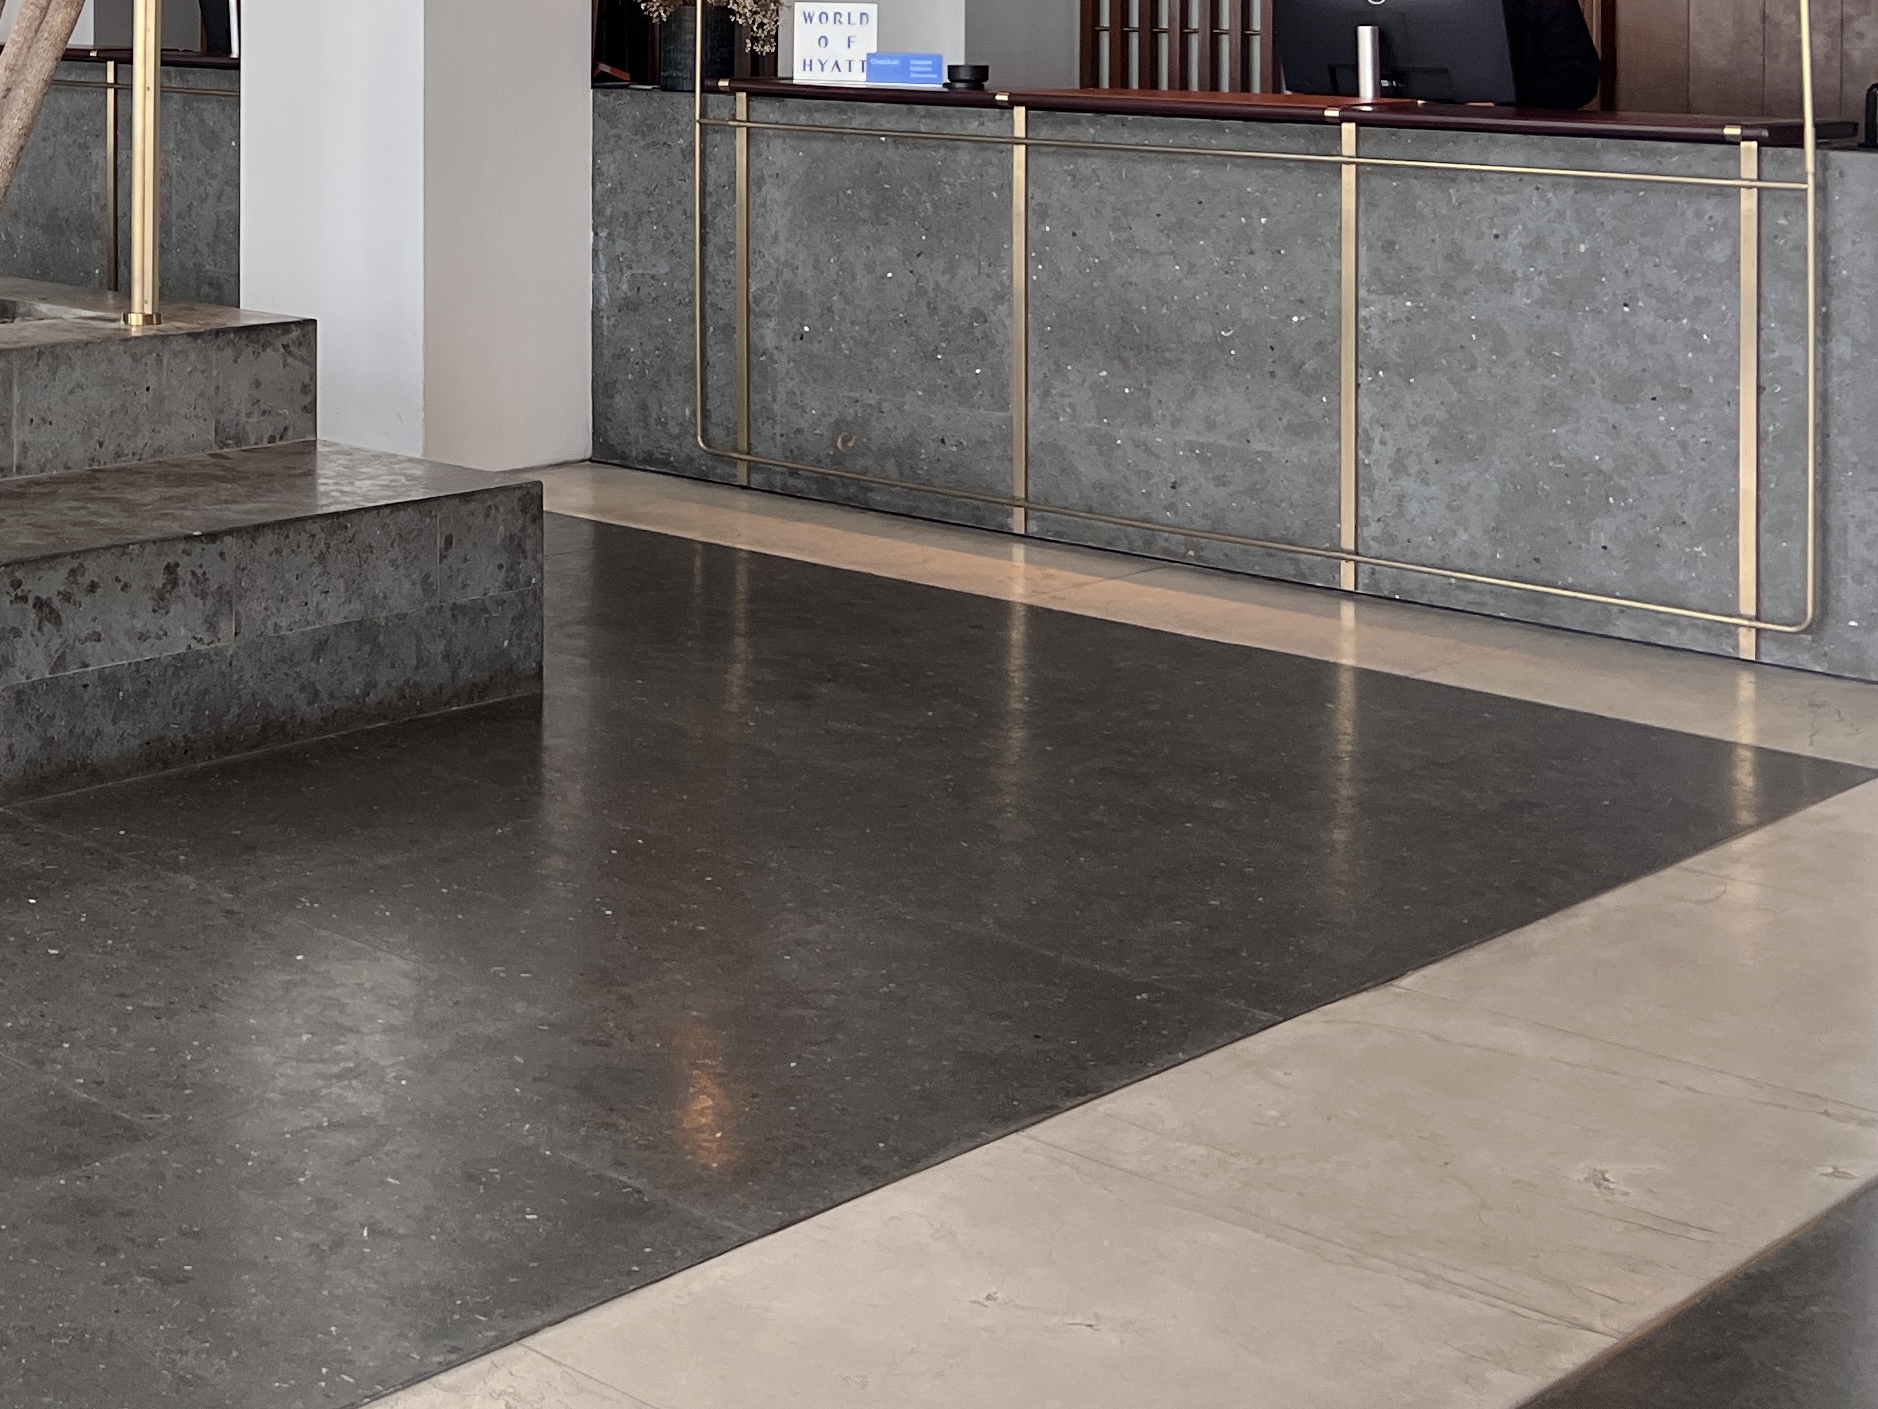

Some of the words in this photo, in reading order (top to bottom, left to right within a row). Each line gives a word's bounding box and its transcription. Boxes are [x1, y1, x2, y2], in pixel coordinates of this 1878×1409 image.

[802, 10, 870, 26] WORLD
[817, 35, 857, 49] OF
[802, 58, 867, 73] HYATT
